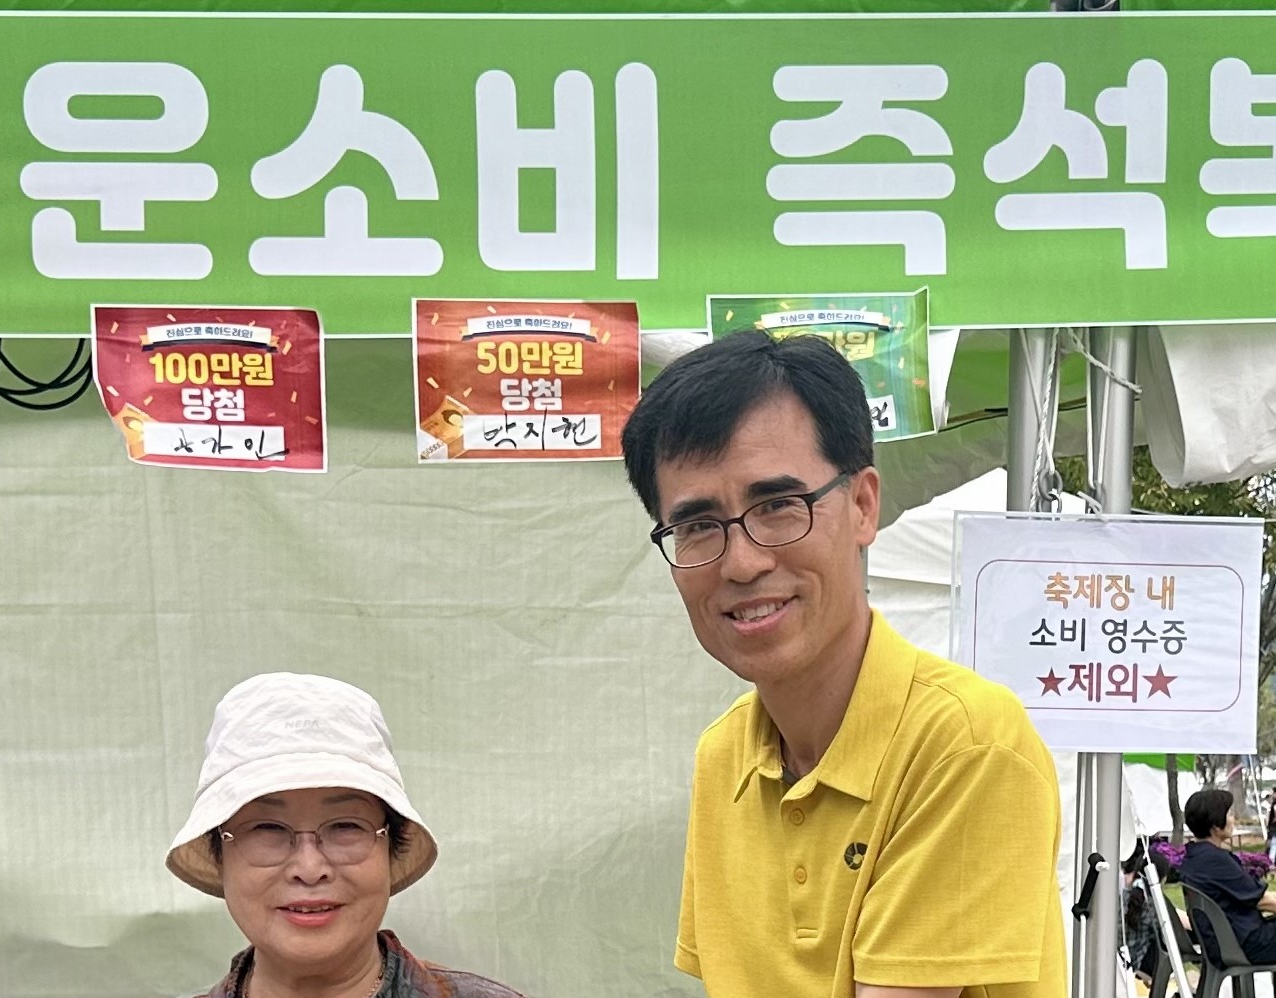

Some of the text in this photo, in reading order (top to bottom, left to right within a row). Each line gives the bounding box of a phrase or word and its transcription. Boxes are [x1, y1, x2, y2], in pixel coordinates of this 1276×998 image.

[165, 325, 253, 339] 진심으로 축하드려요!
[486, 318, 572, 330] 진심으로 축하드려요!
[148, 352, 274, 386] 100만원
[476, 341, 584, 376] 50만원
[181, 388, 246, 422] 당첨
[500, 377, 562, 412] 당첨
[1044, 572, 1174, 611] 축제장 내
[1029, 618, 1188, 655] 소비 영수증
